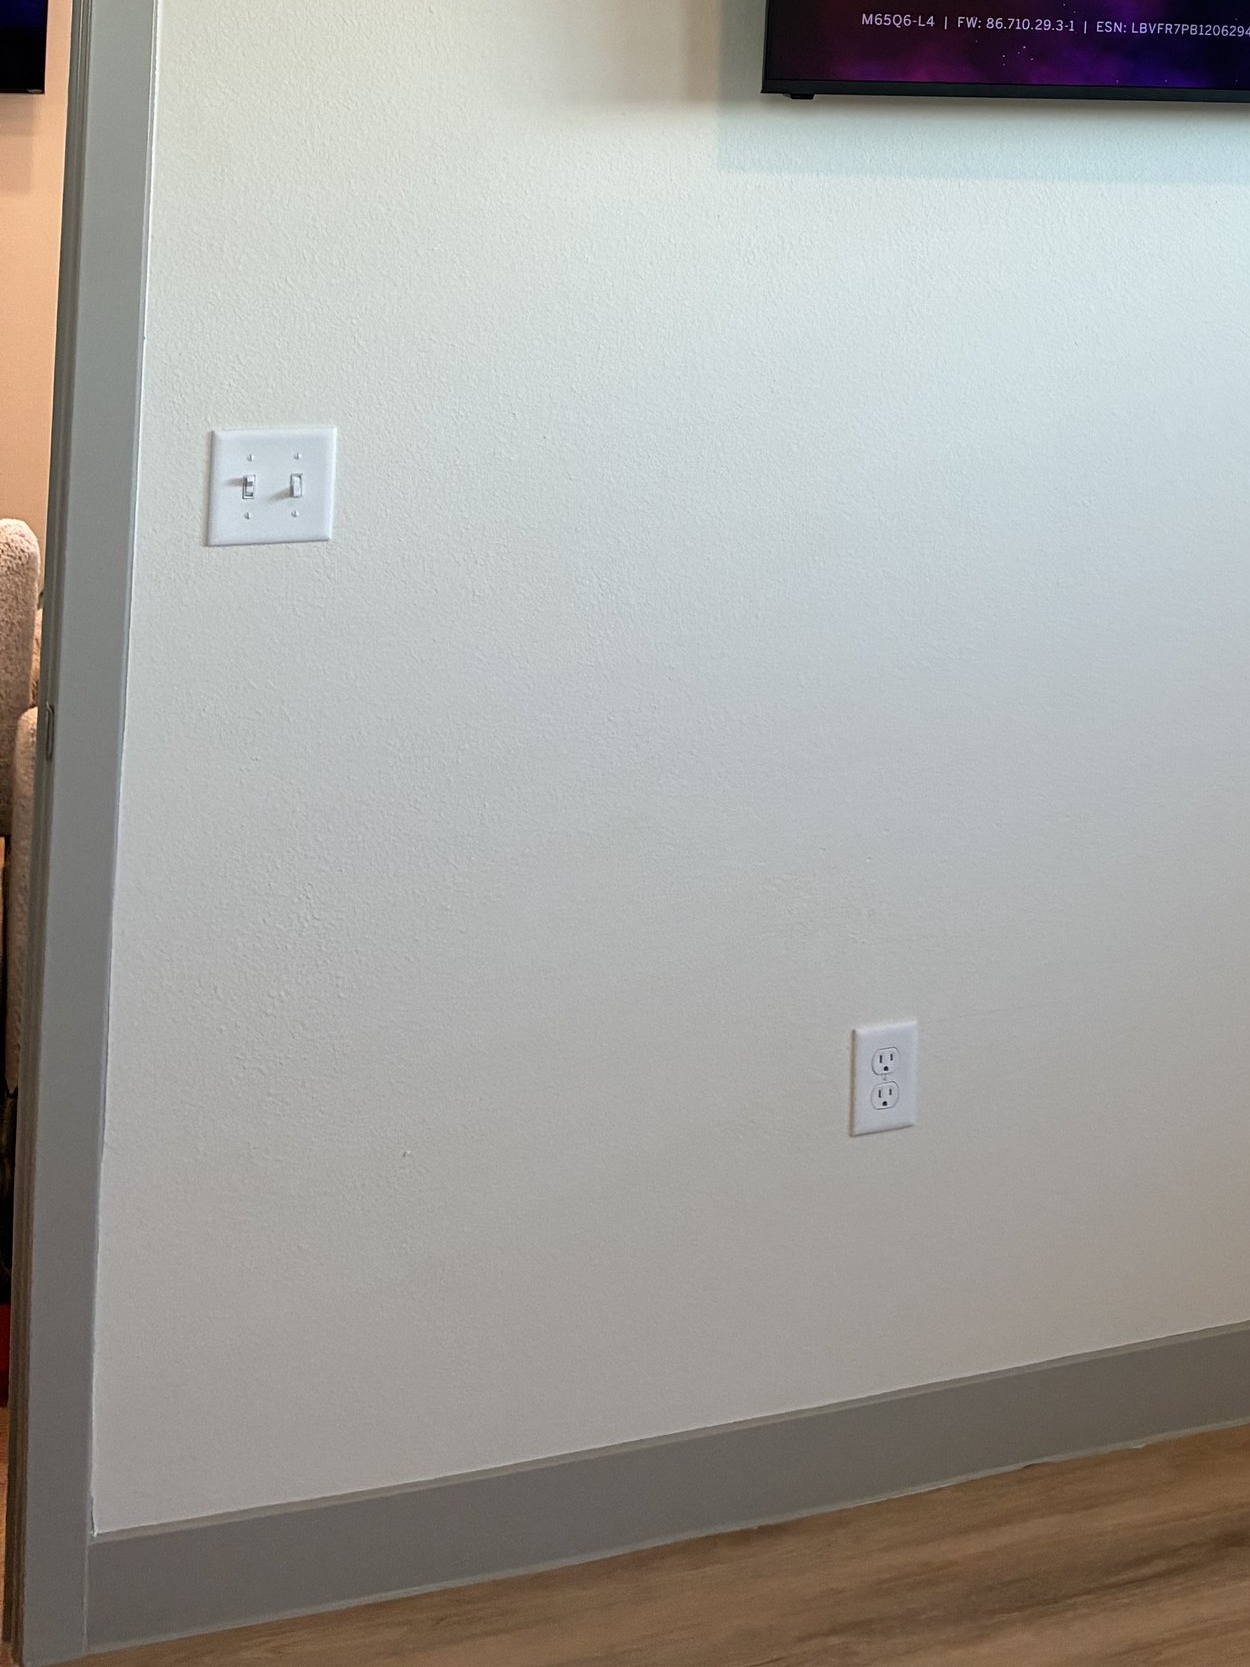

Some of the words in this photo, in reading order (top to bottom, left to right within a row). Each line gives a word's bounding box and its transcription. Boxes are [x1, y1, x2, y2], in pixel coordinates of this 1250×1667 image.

[861, 13, 936, 28] M65Q6-L4
[957, 16, 982, 29] FW:
[985, 17, 1076, 32] 86.710.29.3-1
[1096, 21, 1128, 34] ESN:
